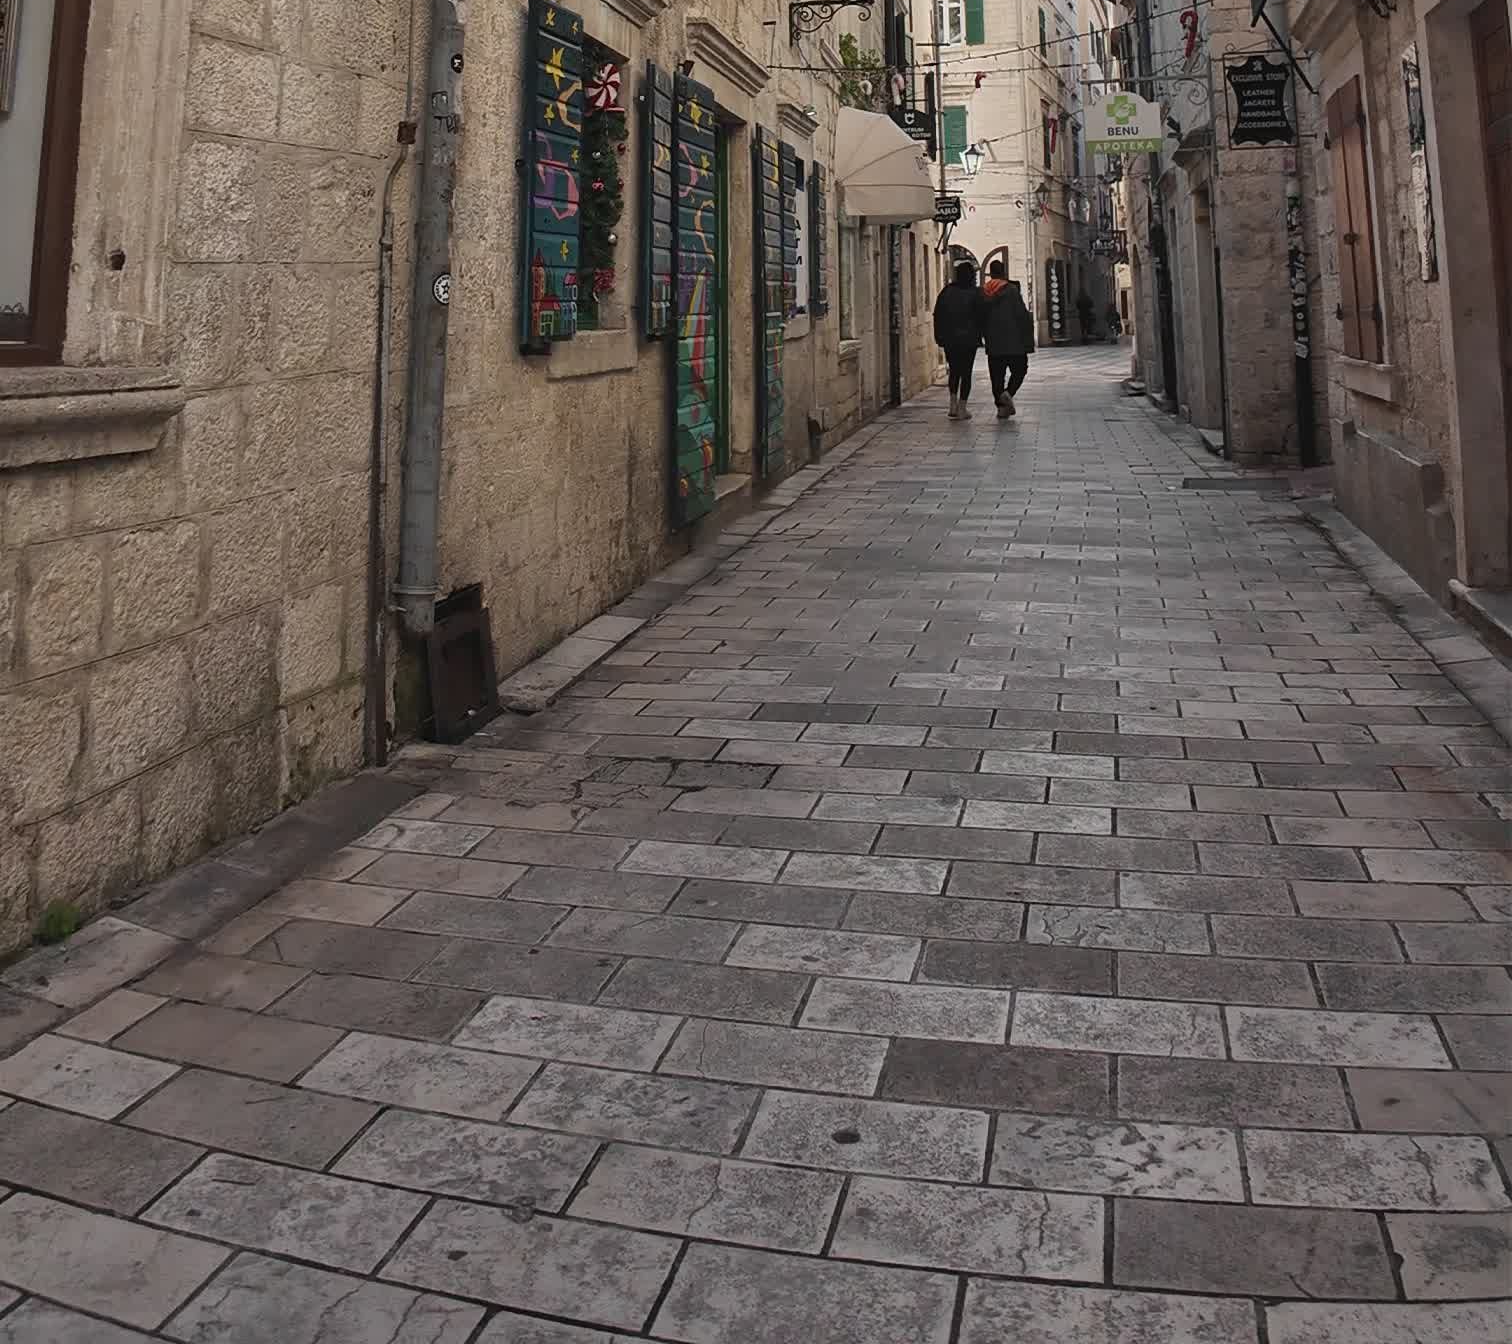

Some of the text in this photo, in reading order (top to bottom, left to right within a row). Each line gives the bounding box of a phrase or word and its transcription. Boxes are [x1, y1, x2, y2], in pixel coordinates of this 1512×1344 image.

[1242, 88, 1275, 96] LEATHER
[1107, 126, 1139, 136] BENU
[1095, 140, 1154, 151] APOTEKA
